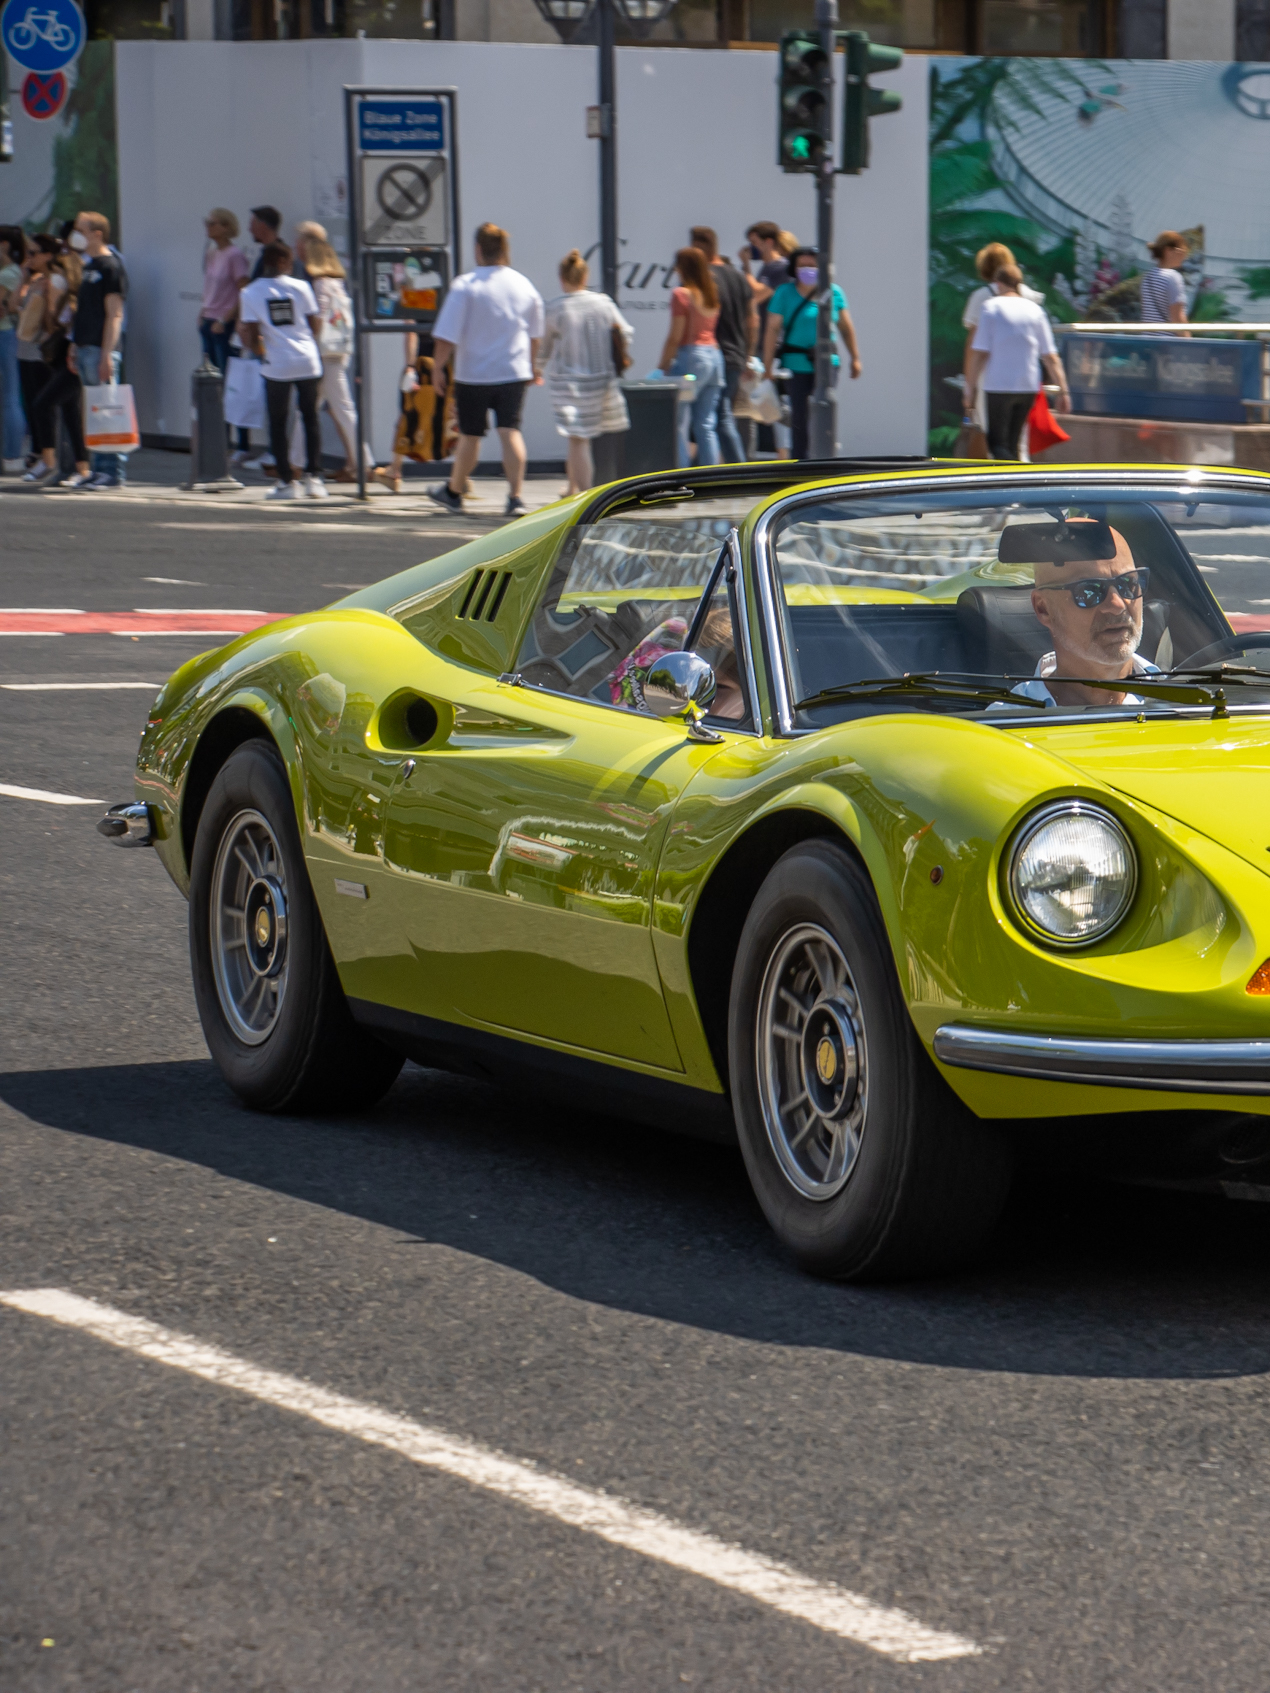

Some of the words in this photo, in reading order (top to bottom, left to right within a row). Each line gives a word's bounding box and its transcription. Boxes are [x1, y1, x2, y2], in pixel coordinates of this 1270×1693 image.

[364, 110, 402, 125] Blaue
[405, 110, 437, 125] Zone
[363, 127, 440, 144] Königsallee
[384, 225, 427, 240] ZONE
